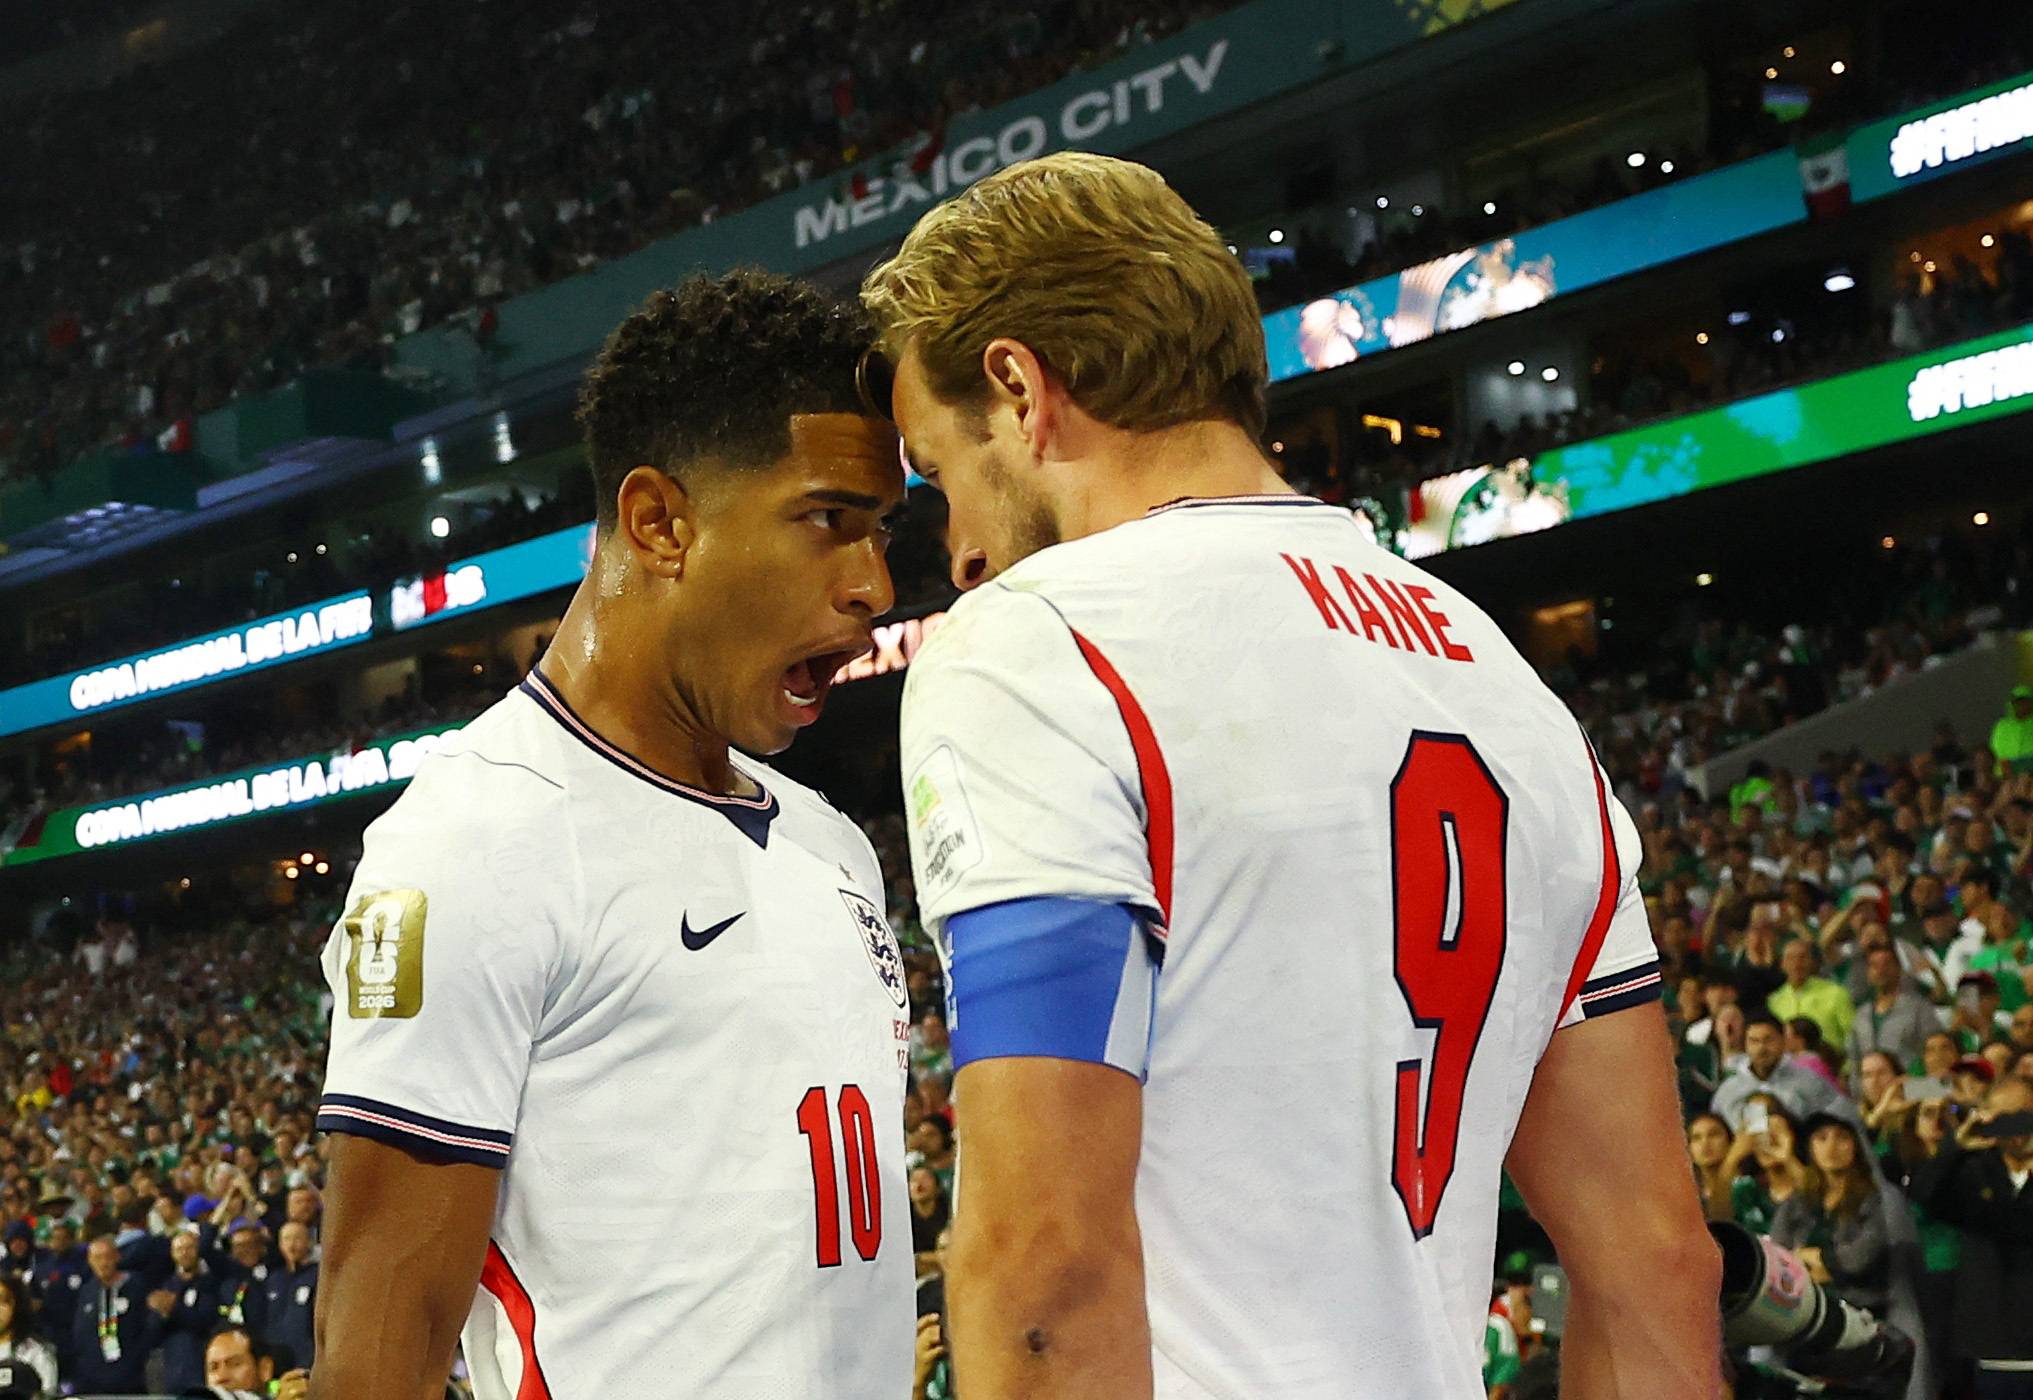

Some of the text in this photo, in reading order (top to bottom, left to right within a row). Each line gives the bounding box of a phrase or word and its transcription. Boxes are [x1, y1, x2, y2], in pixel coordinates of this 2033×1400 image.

[1060, 40, 1229, 142] CITY
[1280, 552, 1475, 663] KANE
[70, 663, 137, 710] COPA
[246, 620, 283, 664] DE
[283, 612, 321, 654] LA
[75, 803, 143, 848] COPA
[252, 769, 290, 811] DE
[288, 761, 327, 803] LA
[358, 995, 396, 1009] 2026
[1389, 729, 1509, 1242] 9
[797, 1084, 882, 1268] 10
